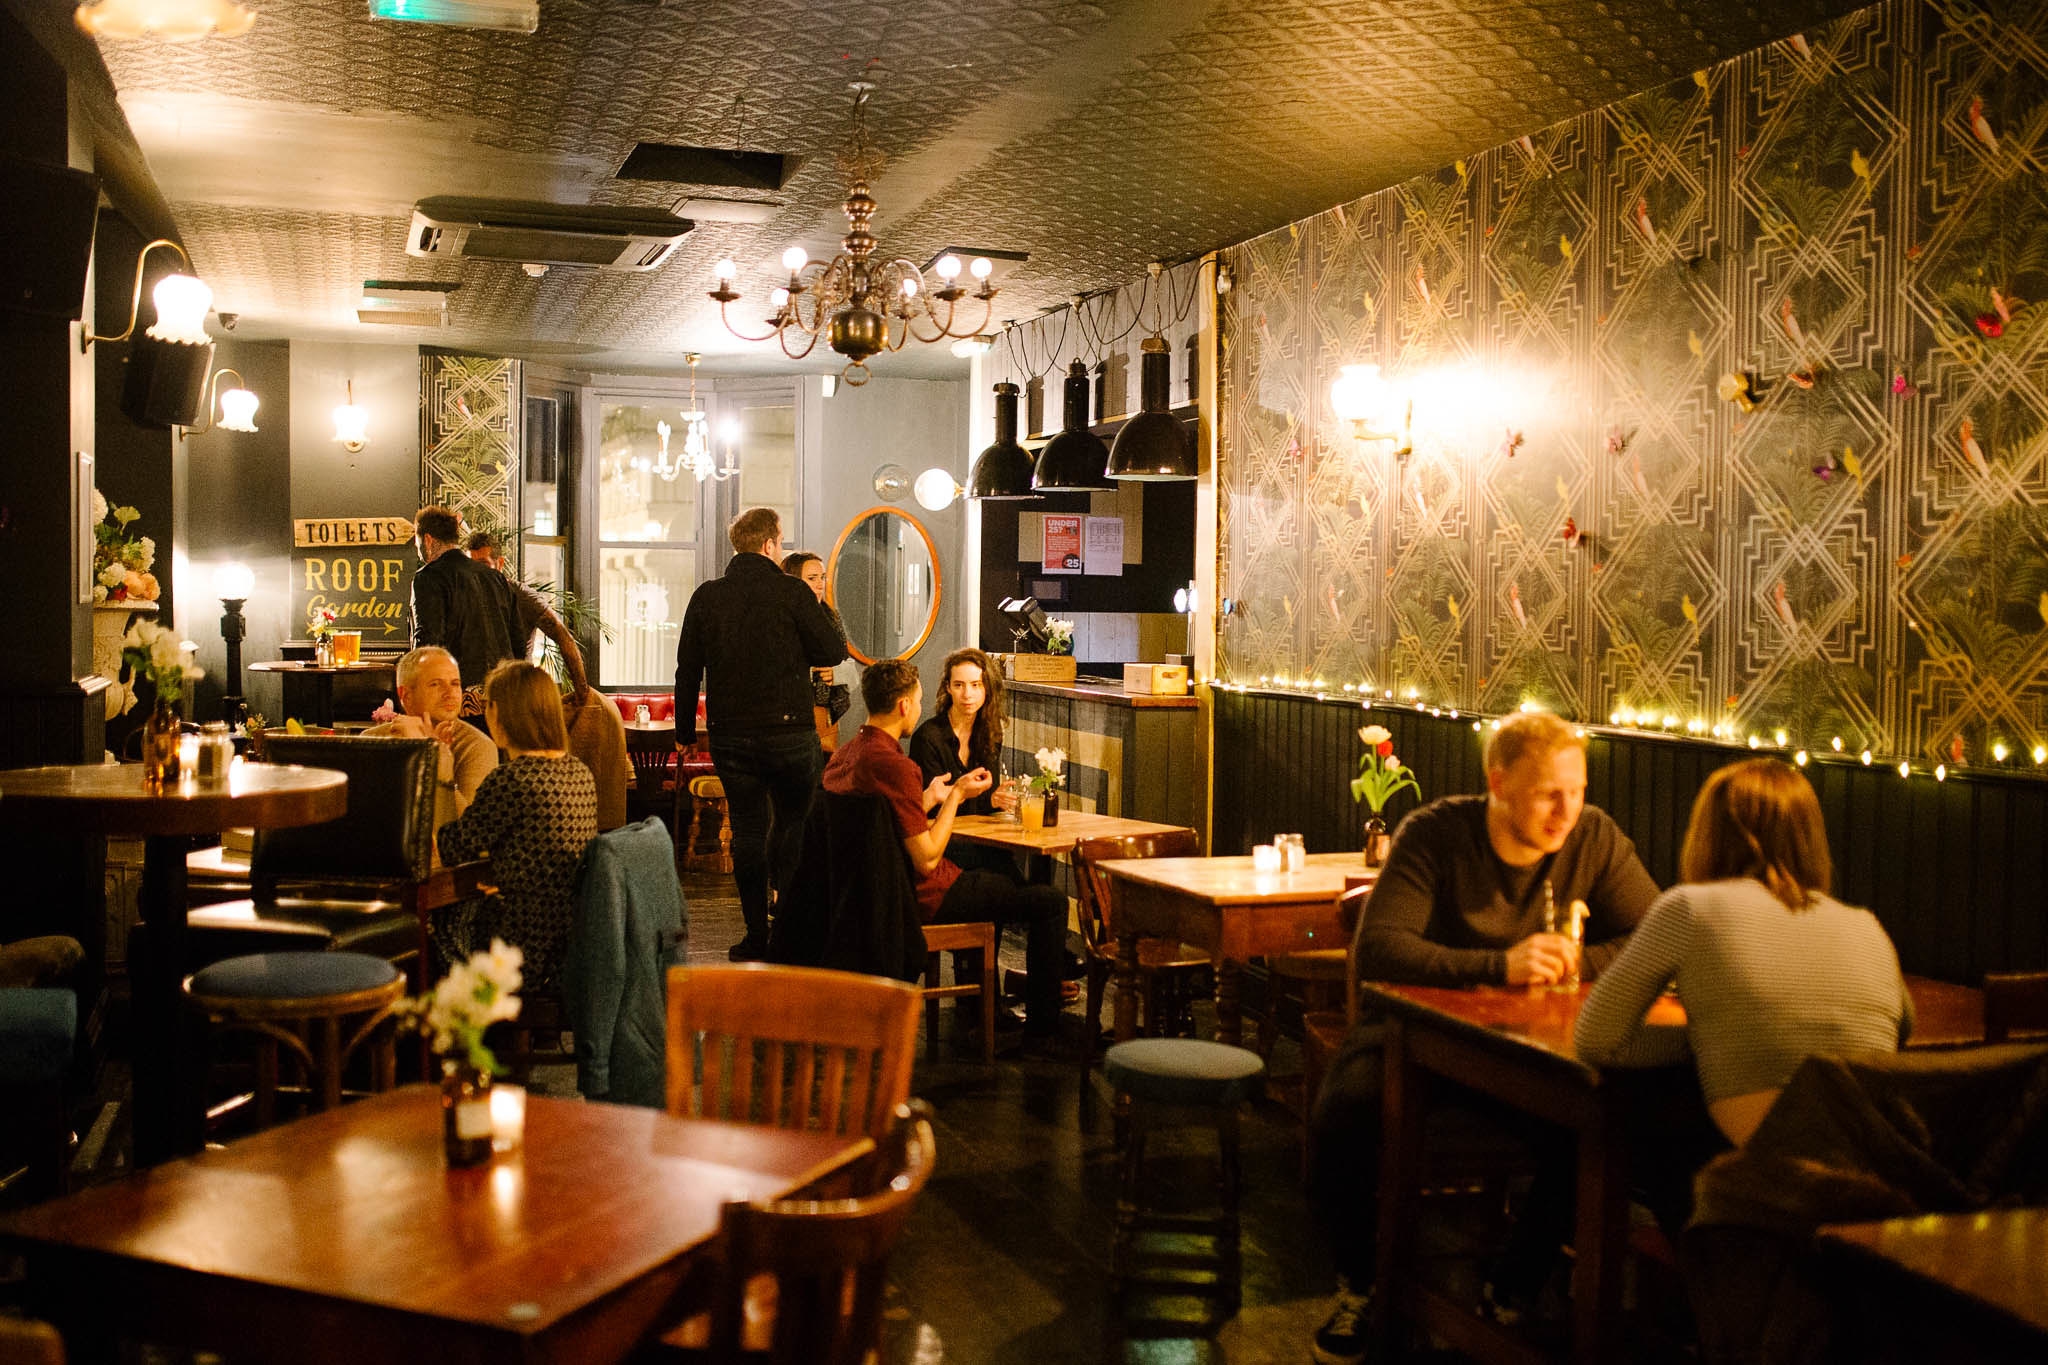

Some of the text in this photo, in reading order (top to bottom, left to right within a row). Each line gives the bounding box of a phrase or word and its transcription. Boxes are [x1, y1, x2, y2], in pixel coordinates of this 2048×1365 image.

[305, 522, 397, 543] TOILETS
[1047, 519, 1078, 527] UNDER
[1066, 558, 1079, 568] 25
[304, 557, 404, 592] ROOF
[306, 594, 403, 619] Garden
